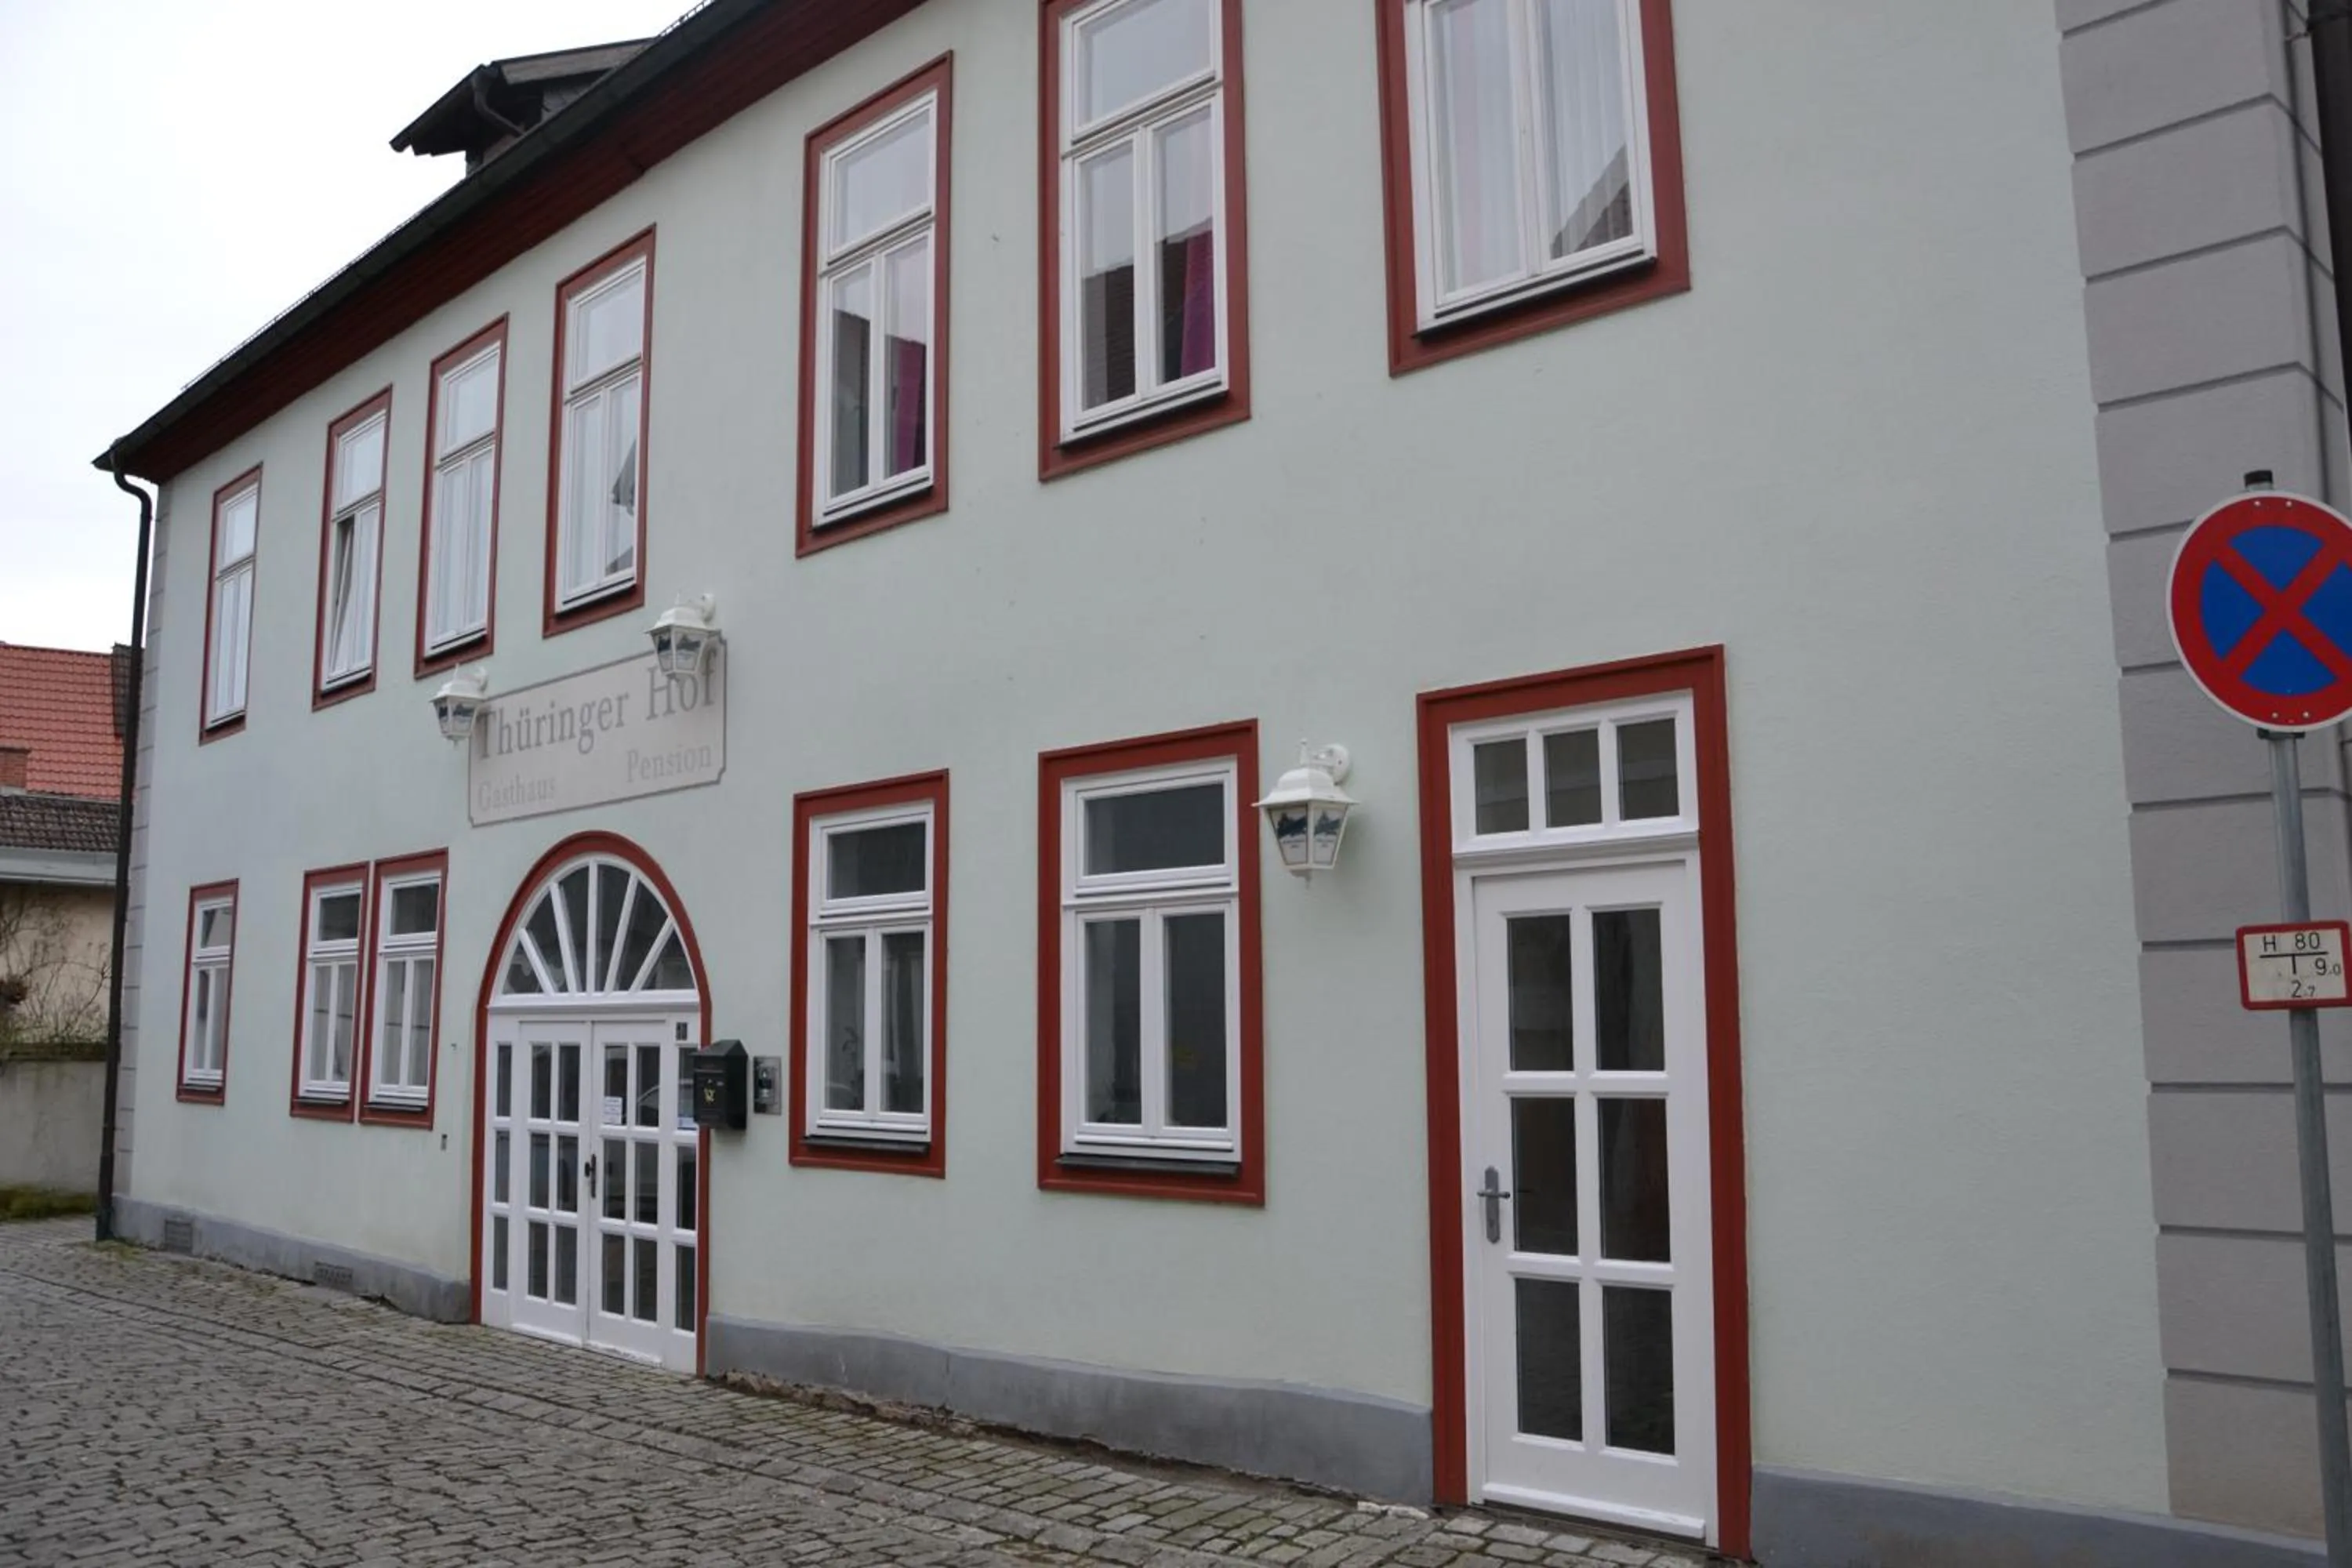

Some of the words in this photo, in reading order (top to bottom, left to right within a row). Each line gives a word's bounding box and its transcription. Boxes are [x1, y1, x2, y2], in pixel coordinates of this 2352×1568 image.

[476, 691, 630, 760] Thüringer
[646, 648, 718, 720] Hof
[478, 772, 557, 811] Gasthaus
[626, 744, 712, 783] Pension
[2263, 935, 2277, 952] H
[2295, 932, 2321, 950] 80
